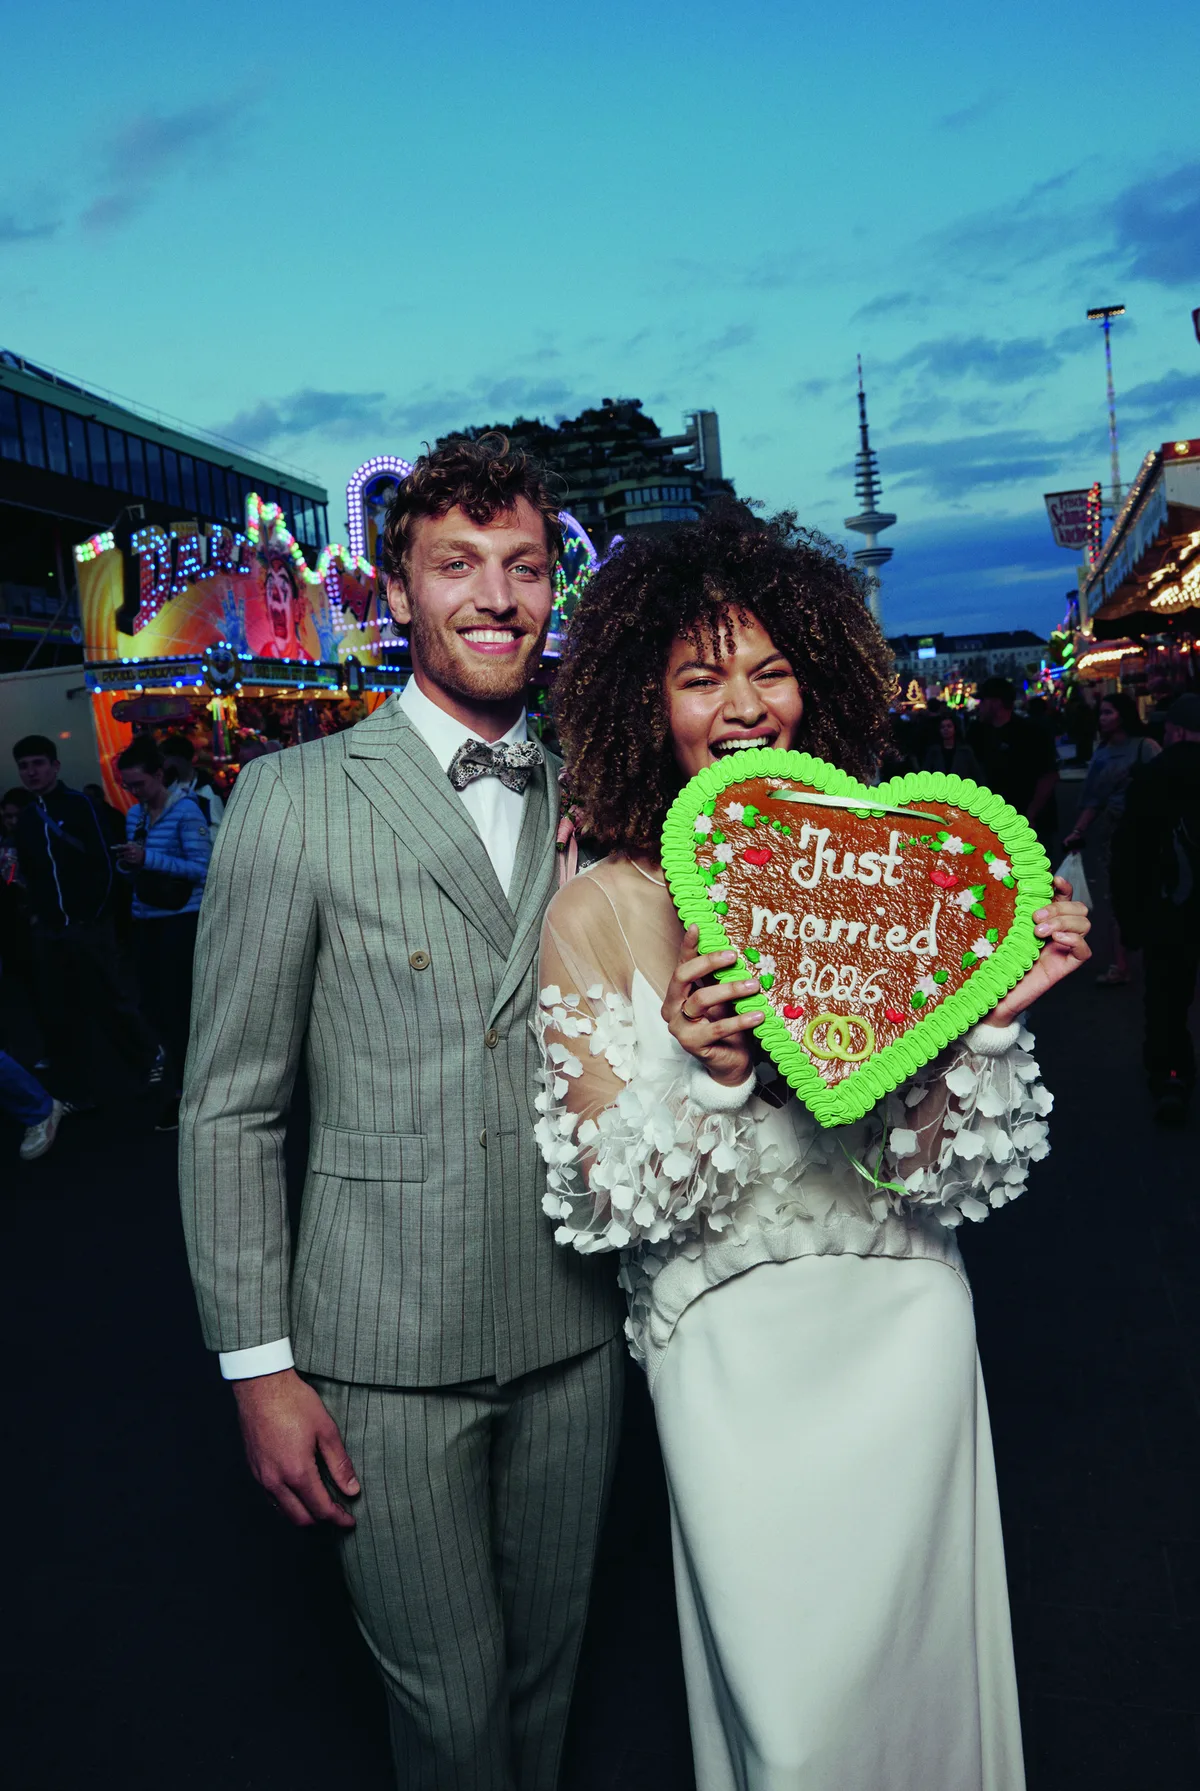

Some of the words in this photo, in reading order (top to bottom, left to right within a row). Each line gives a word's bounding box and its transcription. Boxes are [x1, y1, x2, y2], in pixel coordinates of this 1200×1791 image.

[791, 824, 904, 889] Just
[751, 900, 941, 957] married
[793, 959, 889, 1004] 2026
